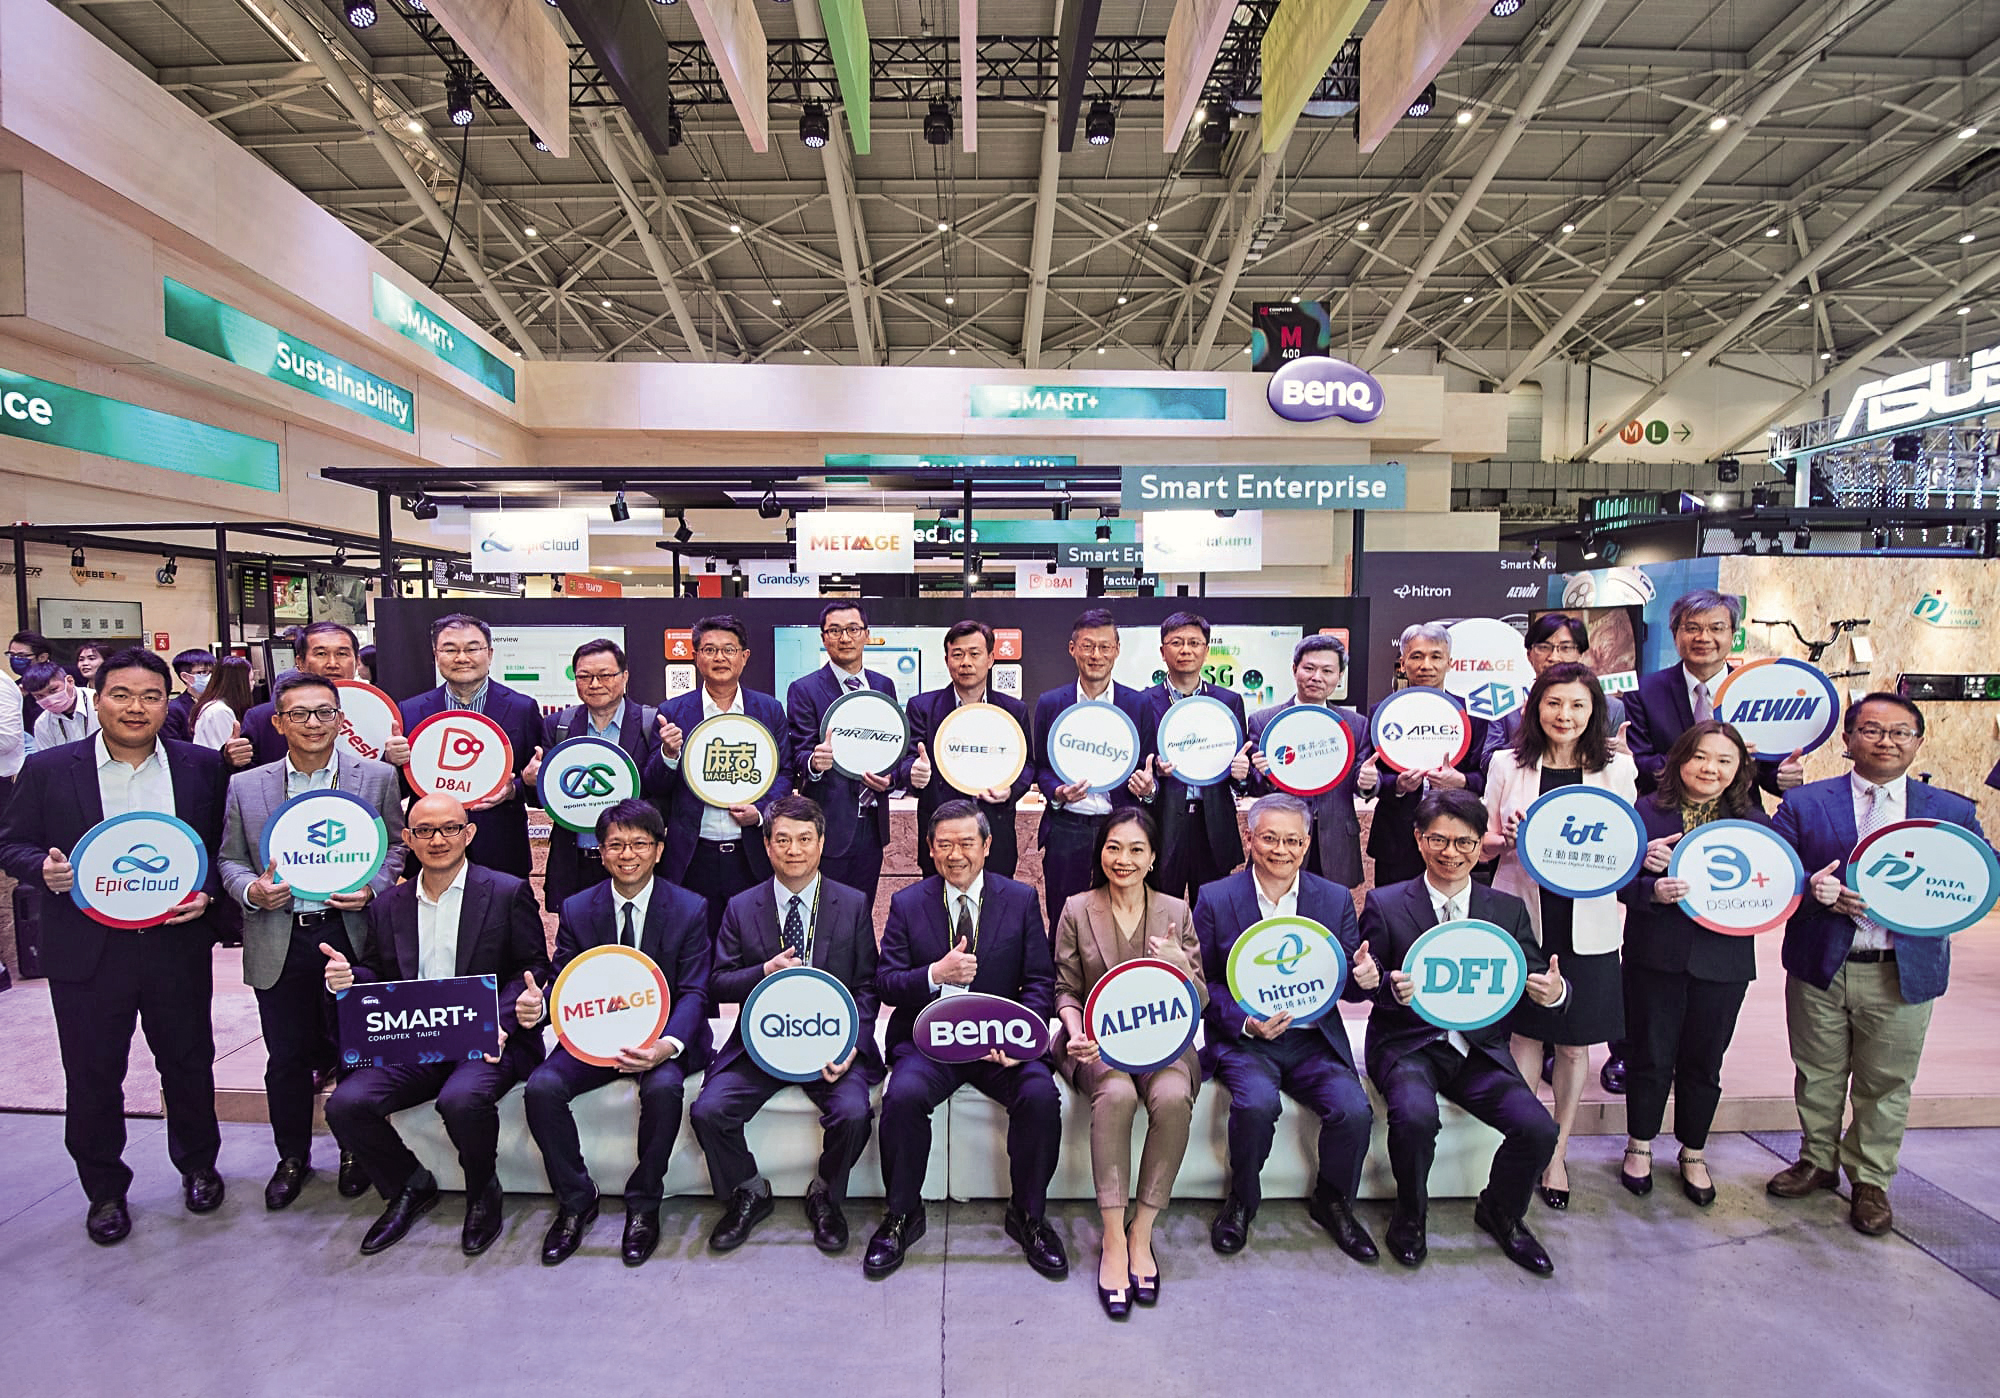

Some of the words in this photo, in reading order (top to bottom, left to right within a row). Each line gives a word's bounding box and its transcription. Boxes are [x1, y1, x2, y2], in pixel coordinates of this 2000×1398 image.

[1281, 326, 1301, 348] M
[1282, 349, 1300, 358] 400
[276, 341, 409, 424] Sustainability
[1008, 391, 1099, 411] SMART+
[1282, 380, 1374, 411] BenQ
[1624, 423, 1639, 441] M
[1651, 423, 1662, 441] L
[1140, 475, 1227, 501] Smart
[1237, 475, 1387, 505] Enterprise
[1068, 547, 1119, 562] Smart
[1500, 559, 1531, 570] Smart
[757, 573, 810, 587] Grandsys
[1411, 585, 1452, 597] hitron
[1407, 725, 1459, 735] APLEX
[1059, 733, 1129, 762] Grandsys
[435, 776, 472, 793] D8AI
[281, 849, 371, 866] MetaGuru
[1926, 875, 1966, 889] DATA
[1706, 897, 1773, 912] DSIGroup
[1926, 888, 1976, 904] IMAGE
[1422, 957, 1508, 996] DFI
[1258, 978, 1325, 1003] hitron
[366, 1005, 478, 1032] SMART+
[1100, 997, 1188, 1037] ALPHA
[759, 1014, 842, 1039] Qisda
[929, 1018, 1037, 1050] BenQ
[368, 1033, 410, 1042] COMPUTEX
[416, 1030, 441, 1038] TAIPEI
